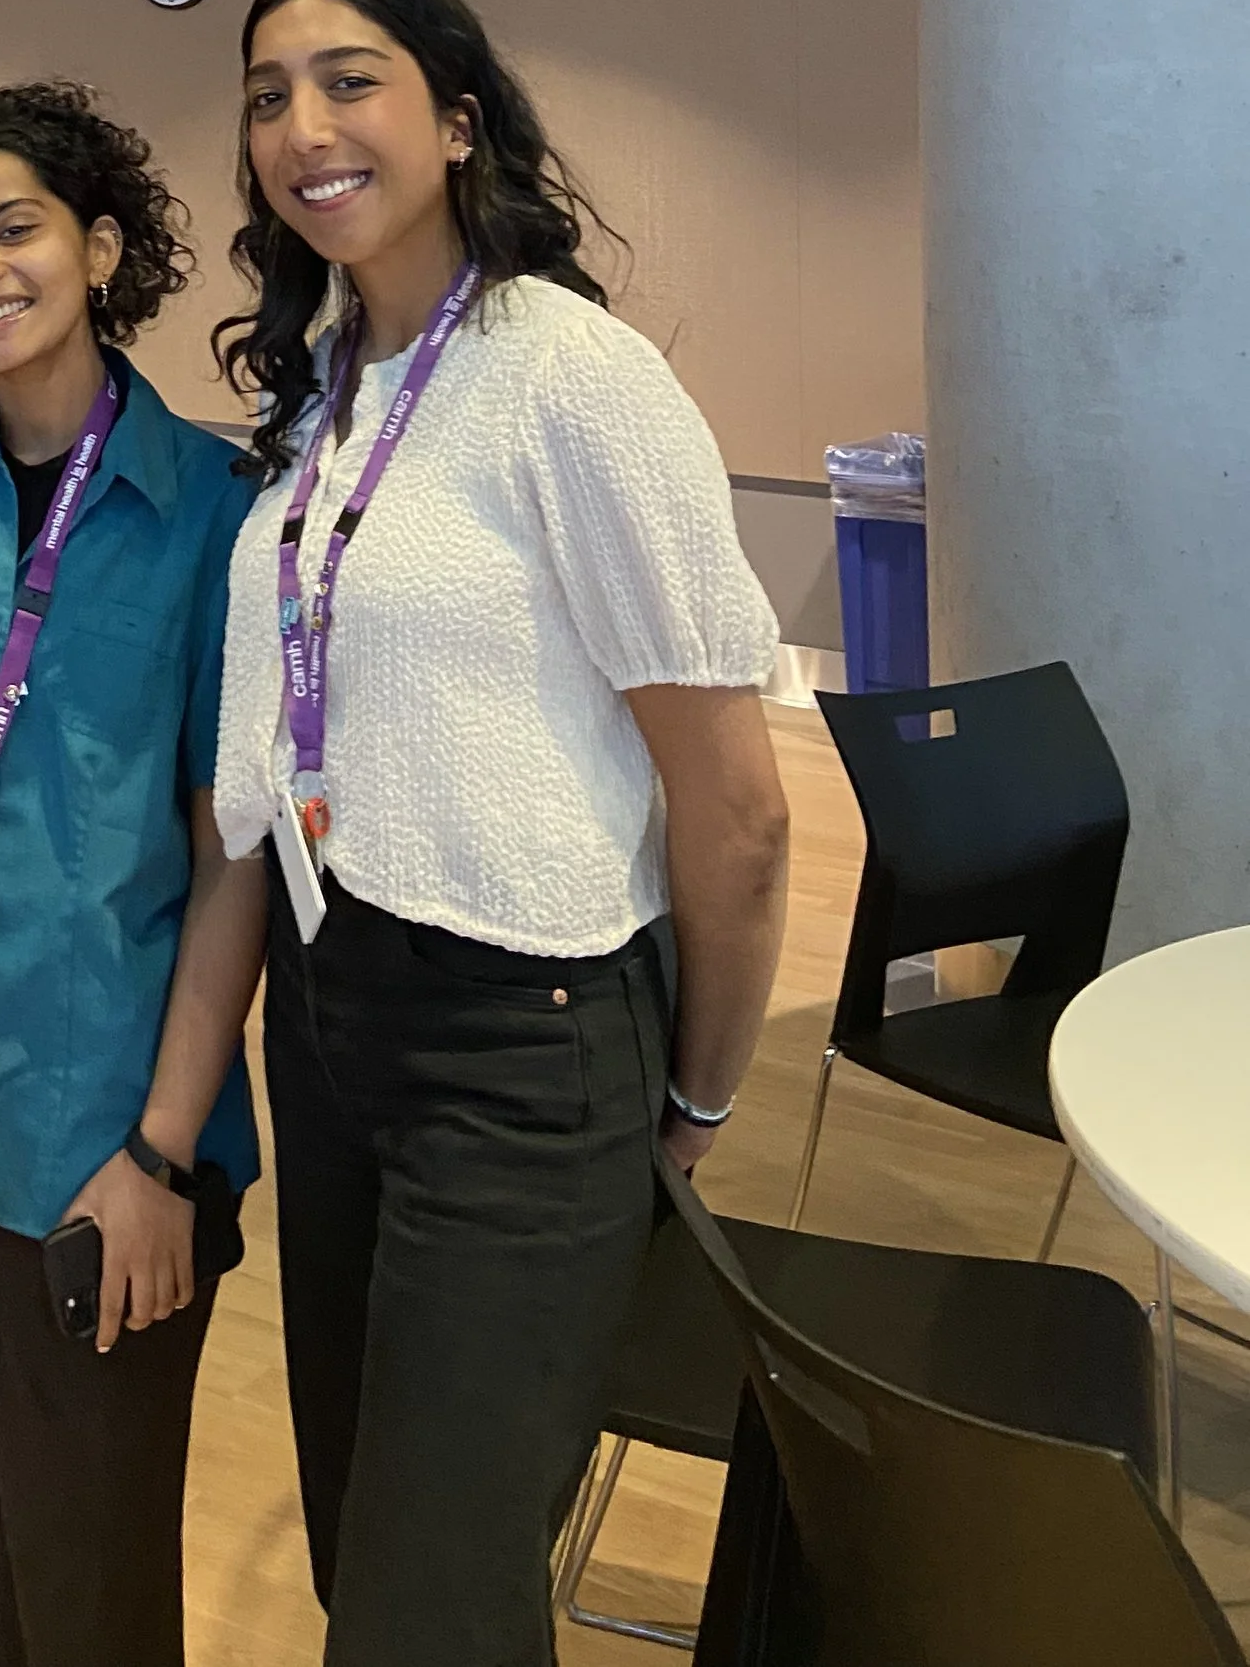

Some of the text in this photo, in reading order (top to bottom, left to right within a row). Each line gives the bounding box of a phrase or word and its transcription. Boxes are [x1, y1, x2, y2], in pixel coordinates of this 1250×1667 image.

[382, 390, 413, 440] camh
[45, 508, 67, 549] mental
[56, 478, 79, 511] health
[74, 433, 97, 466] health
[286, 640, 308, 697] camh
